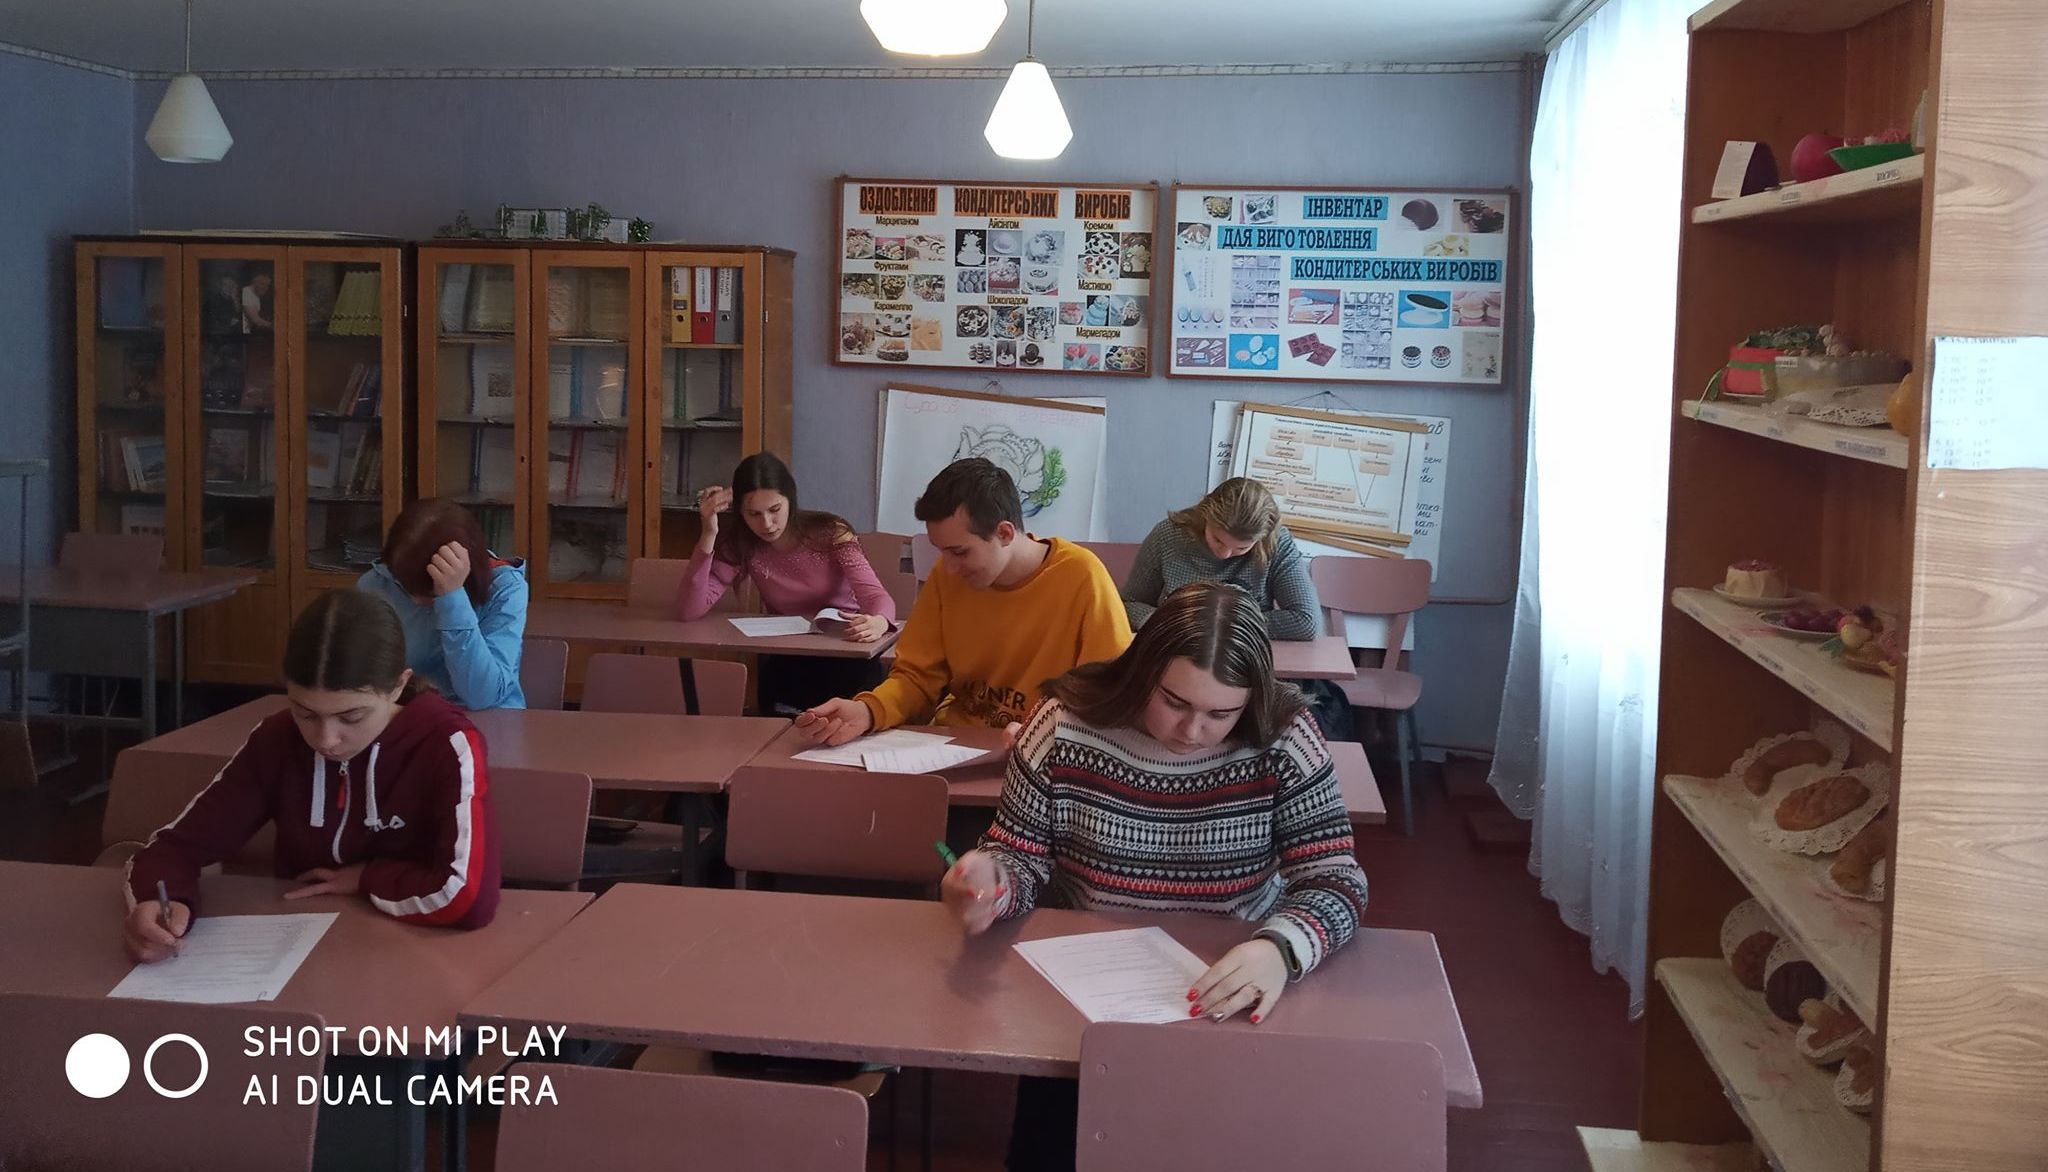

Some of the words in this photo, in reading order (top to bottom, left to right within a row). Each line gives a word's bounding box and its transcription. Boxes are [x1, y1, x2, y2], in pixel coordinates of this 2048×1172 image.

[860, 187, 936, 213] ОЗДОБЛЕННЯ
[954, 188, 1056, 216] КОНДИТЕРСЬКИХ
[1075, 193, 1131, 219] ВИРОБІВ
[1308, 198, 1383, 218] ІНВЕНТАР
[875, 216, 919, 227] Марципаном
[1083, 221, 1114, 231] Кремом
[1222, 228, 1253, 249] ДЛЯ
[874, 261, 909, 271] Фруктами
[1295, 259, 1423, 280] КОНДИТЕРСЬКИХ
[1427, 262, 1497, 281] ВИРОБІВ
[987, 296, 1029, 306] Шоколадом
[1076, 327, 1121, 339] Мармеладом
